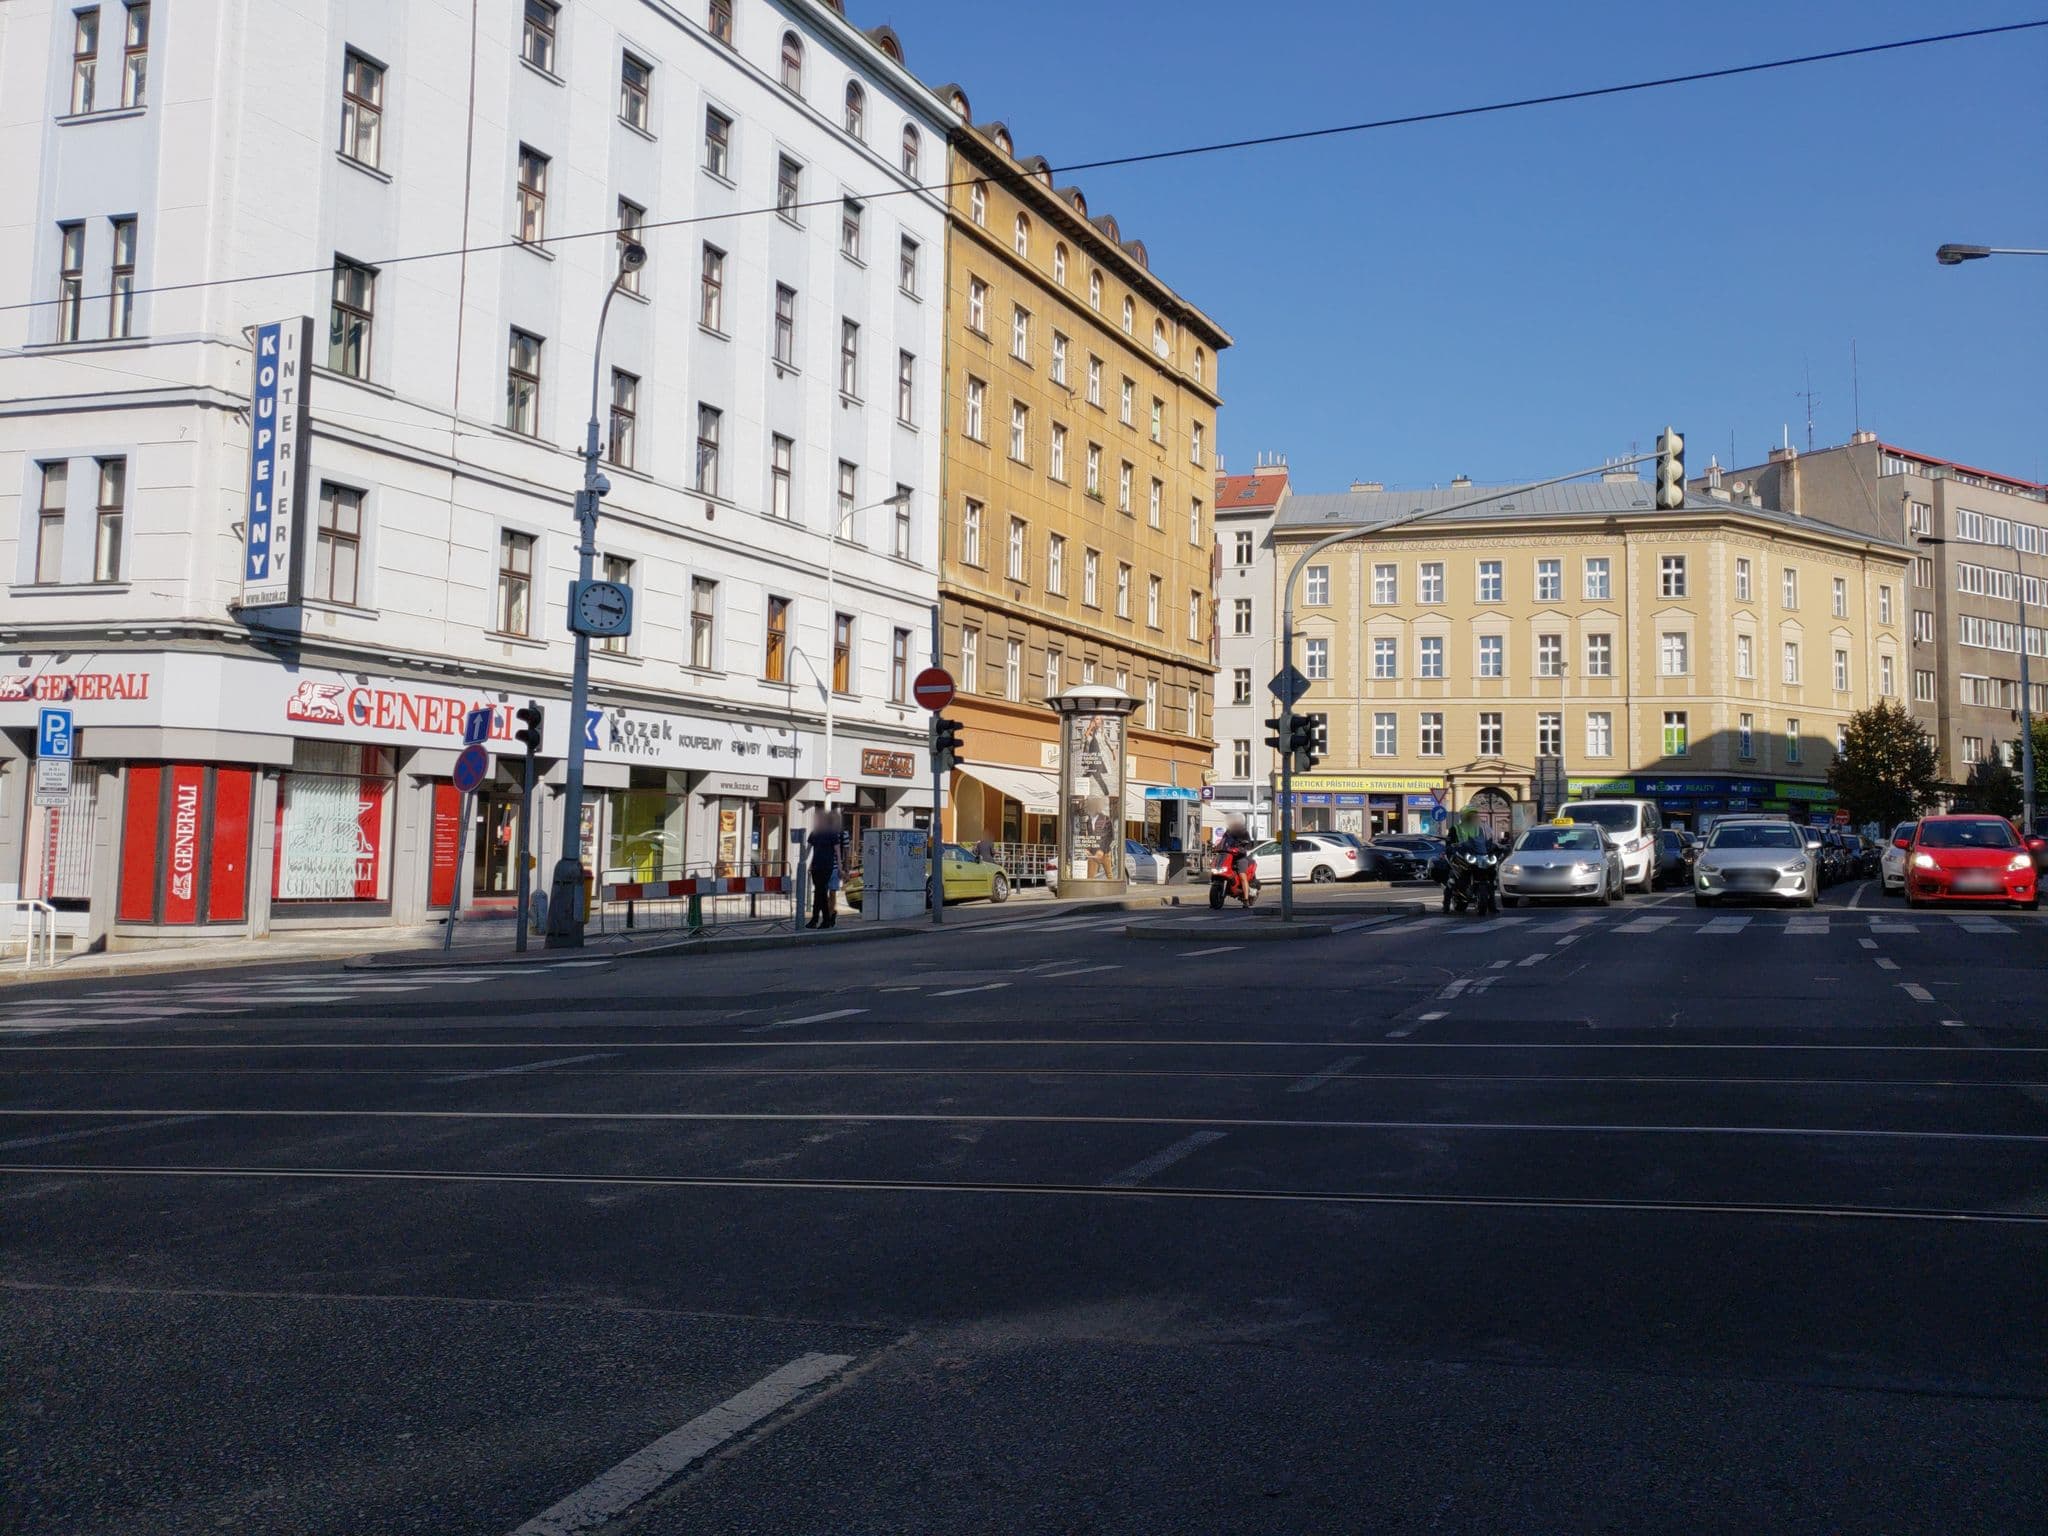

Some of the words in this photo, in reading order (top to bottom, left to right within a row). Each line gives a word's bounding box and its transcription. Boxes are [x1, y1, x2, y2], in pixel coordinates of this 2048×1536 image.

[250, 334, 277, 575] KOUPELNY
[33, 672, 150, 701] GENERALI
[45, 714, 66, 742] P
[347, 687, 515, 741] GENERLI
[678, 734, 724, 751] KOUPELNY
[730, 740, 762, 755] STAVBY
[173, 784, 198, 872] GENERALI
